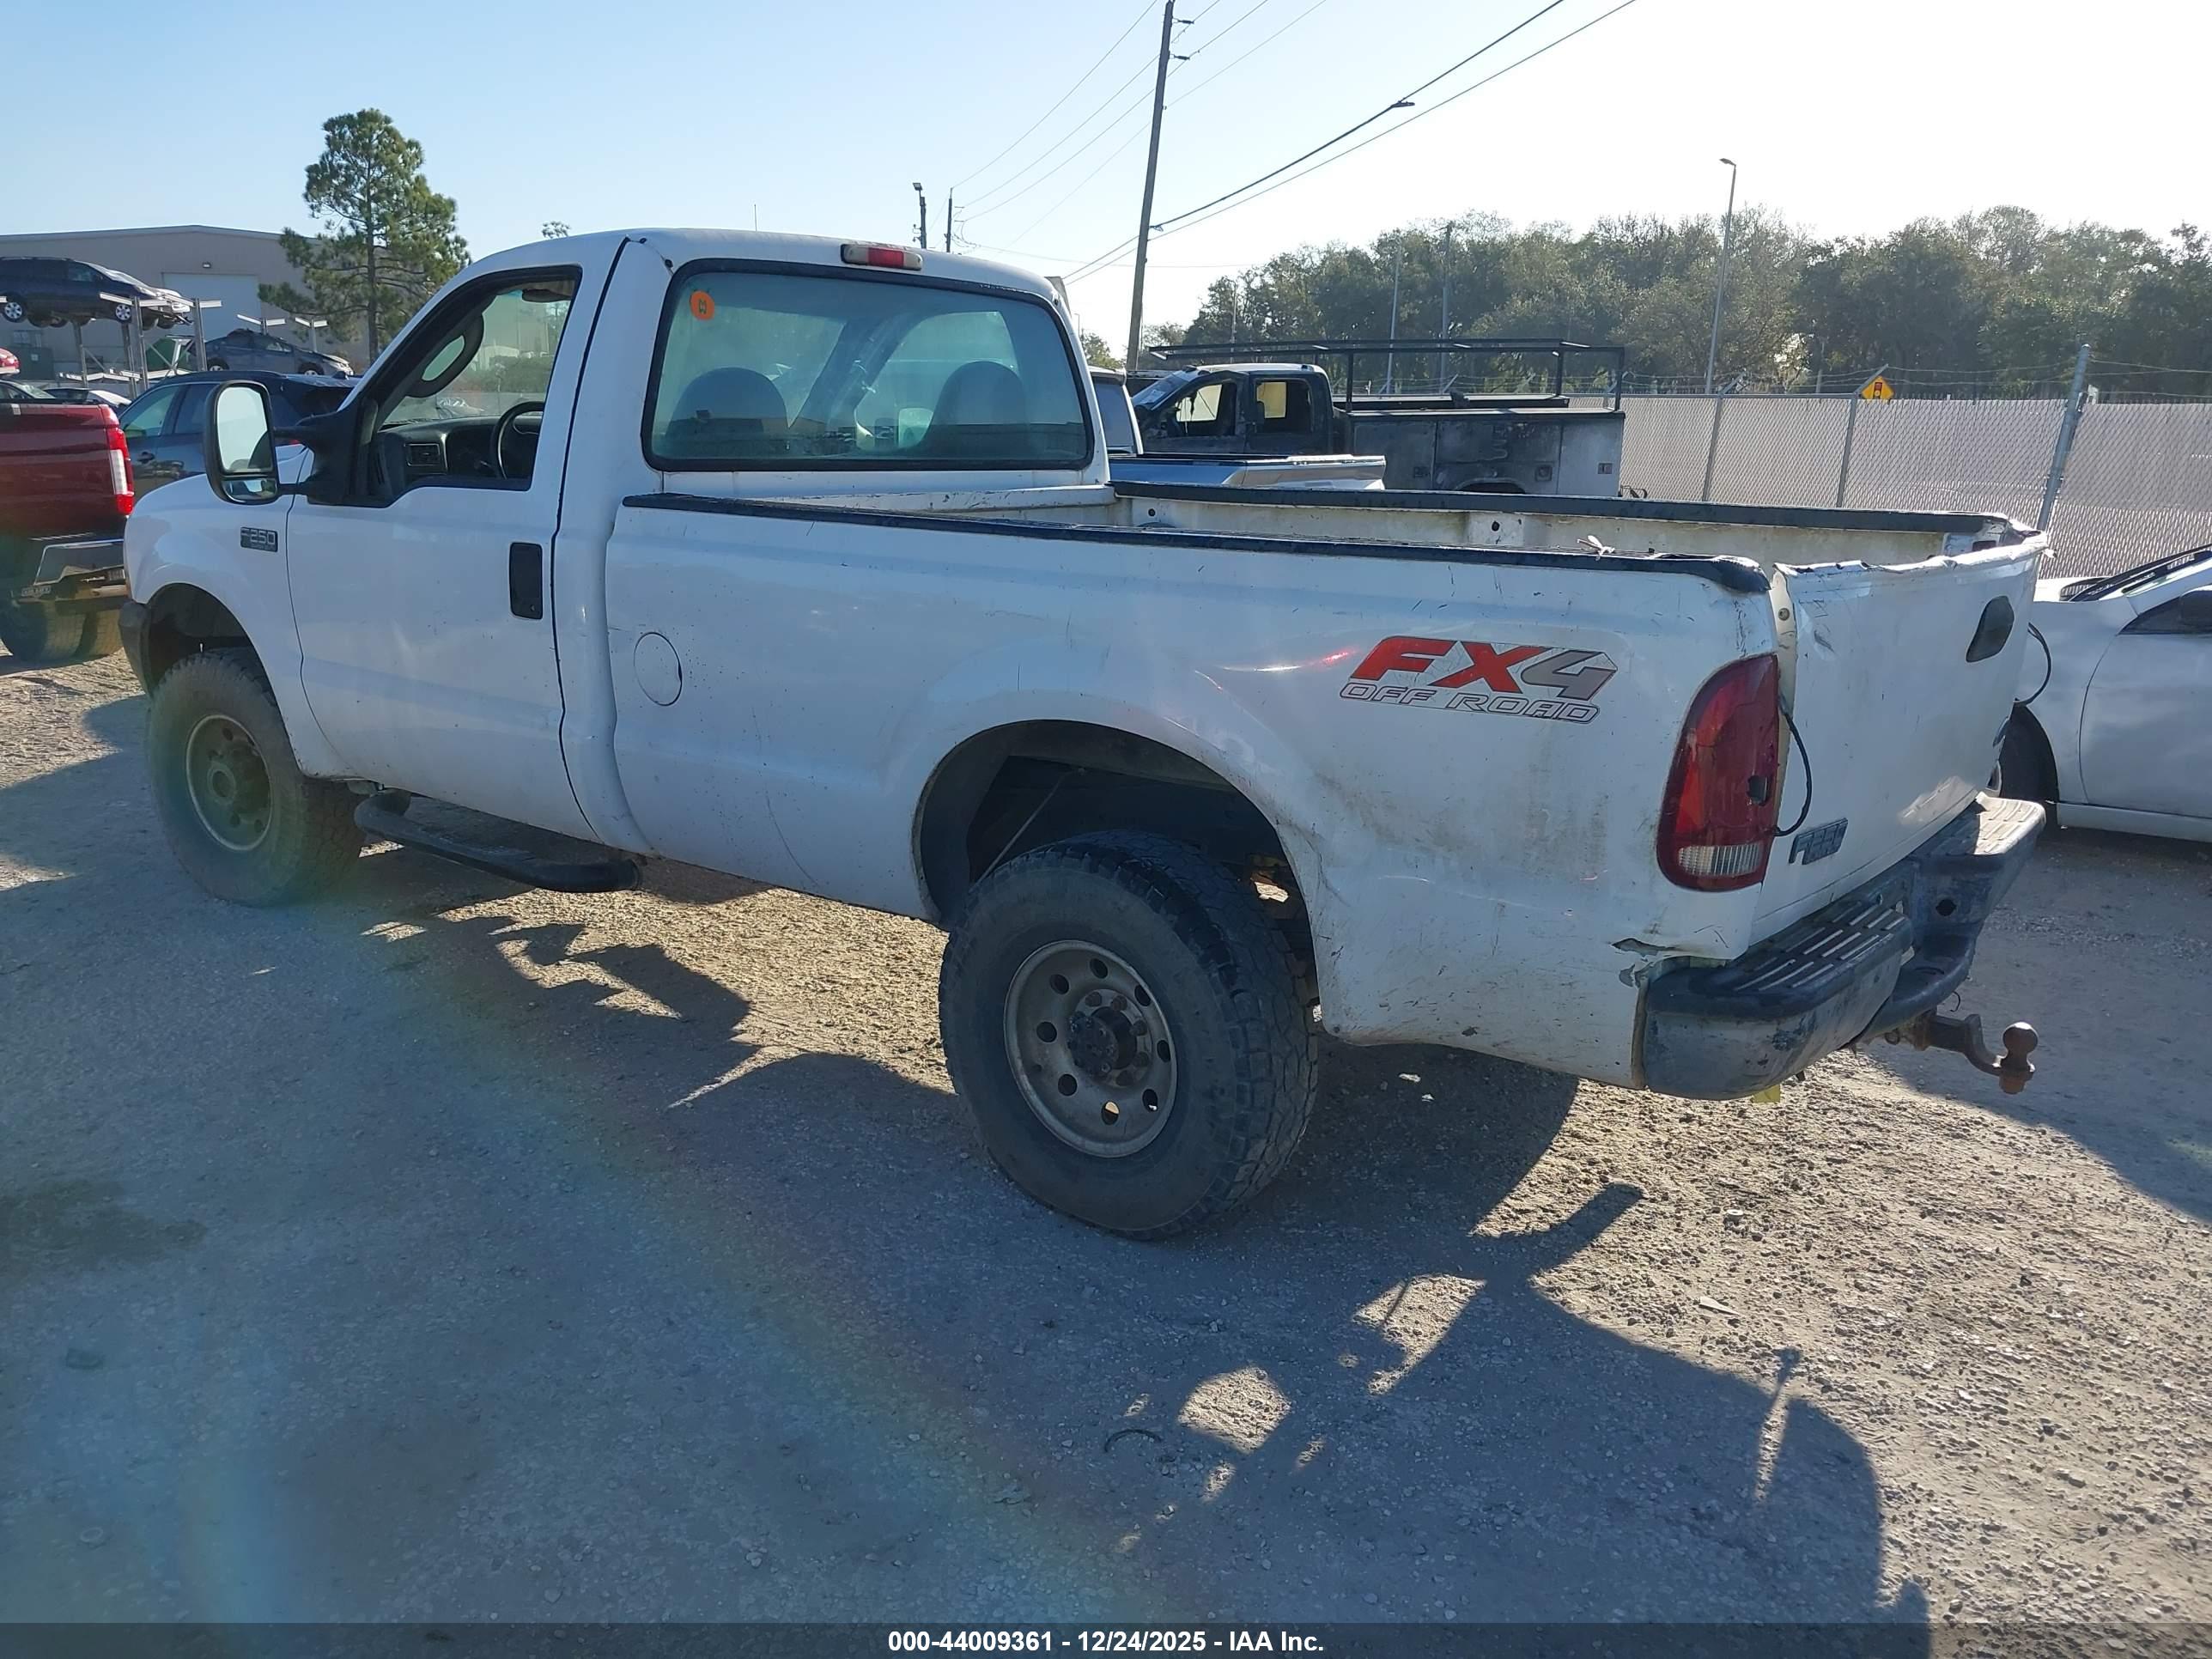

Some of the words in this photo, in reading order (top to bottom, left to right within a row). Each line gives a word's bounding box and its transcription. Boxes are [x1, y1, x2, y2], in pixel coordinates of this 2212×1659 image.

[1350, 635, 1618, 701] FX4
[1340, 682, 1437, 705] OFF
[1445, 692, 1601, 724] ROAD
